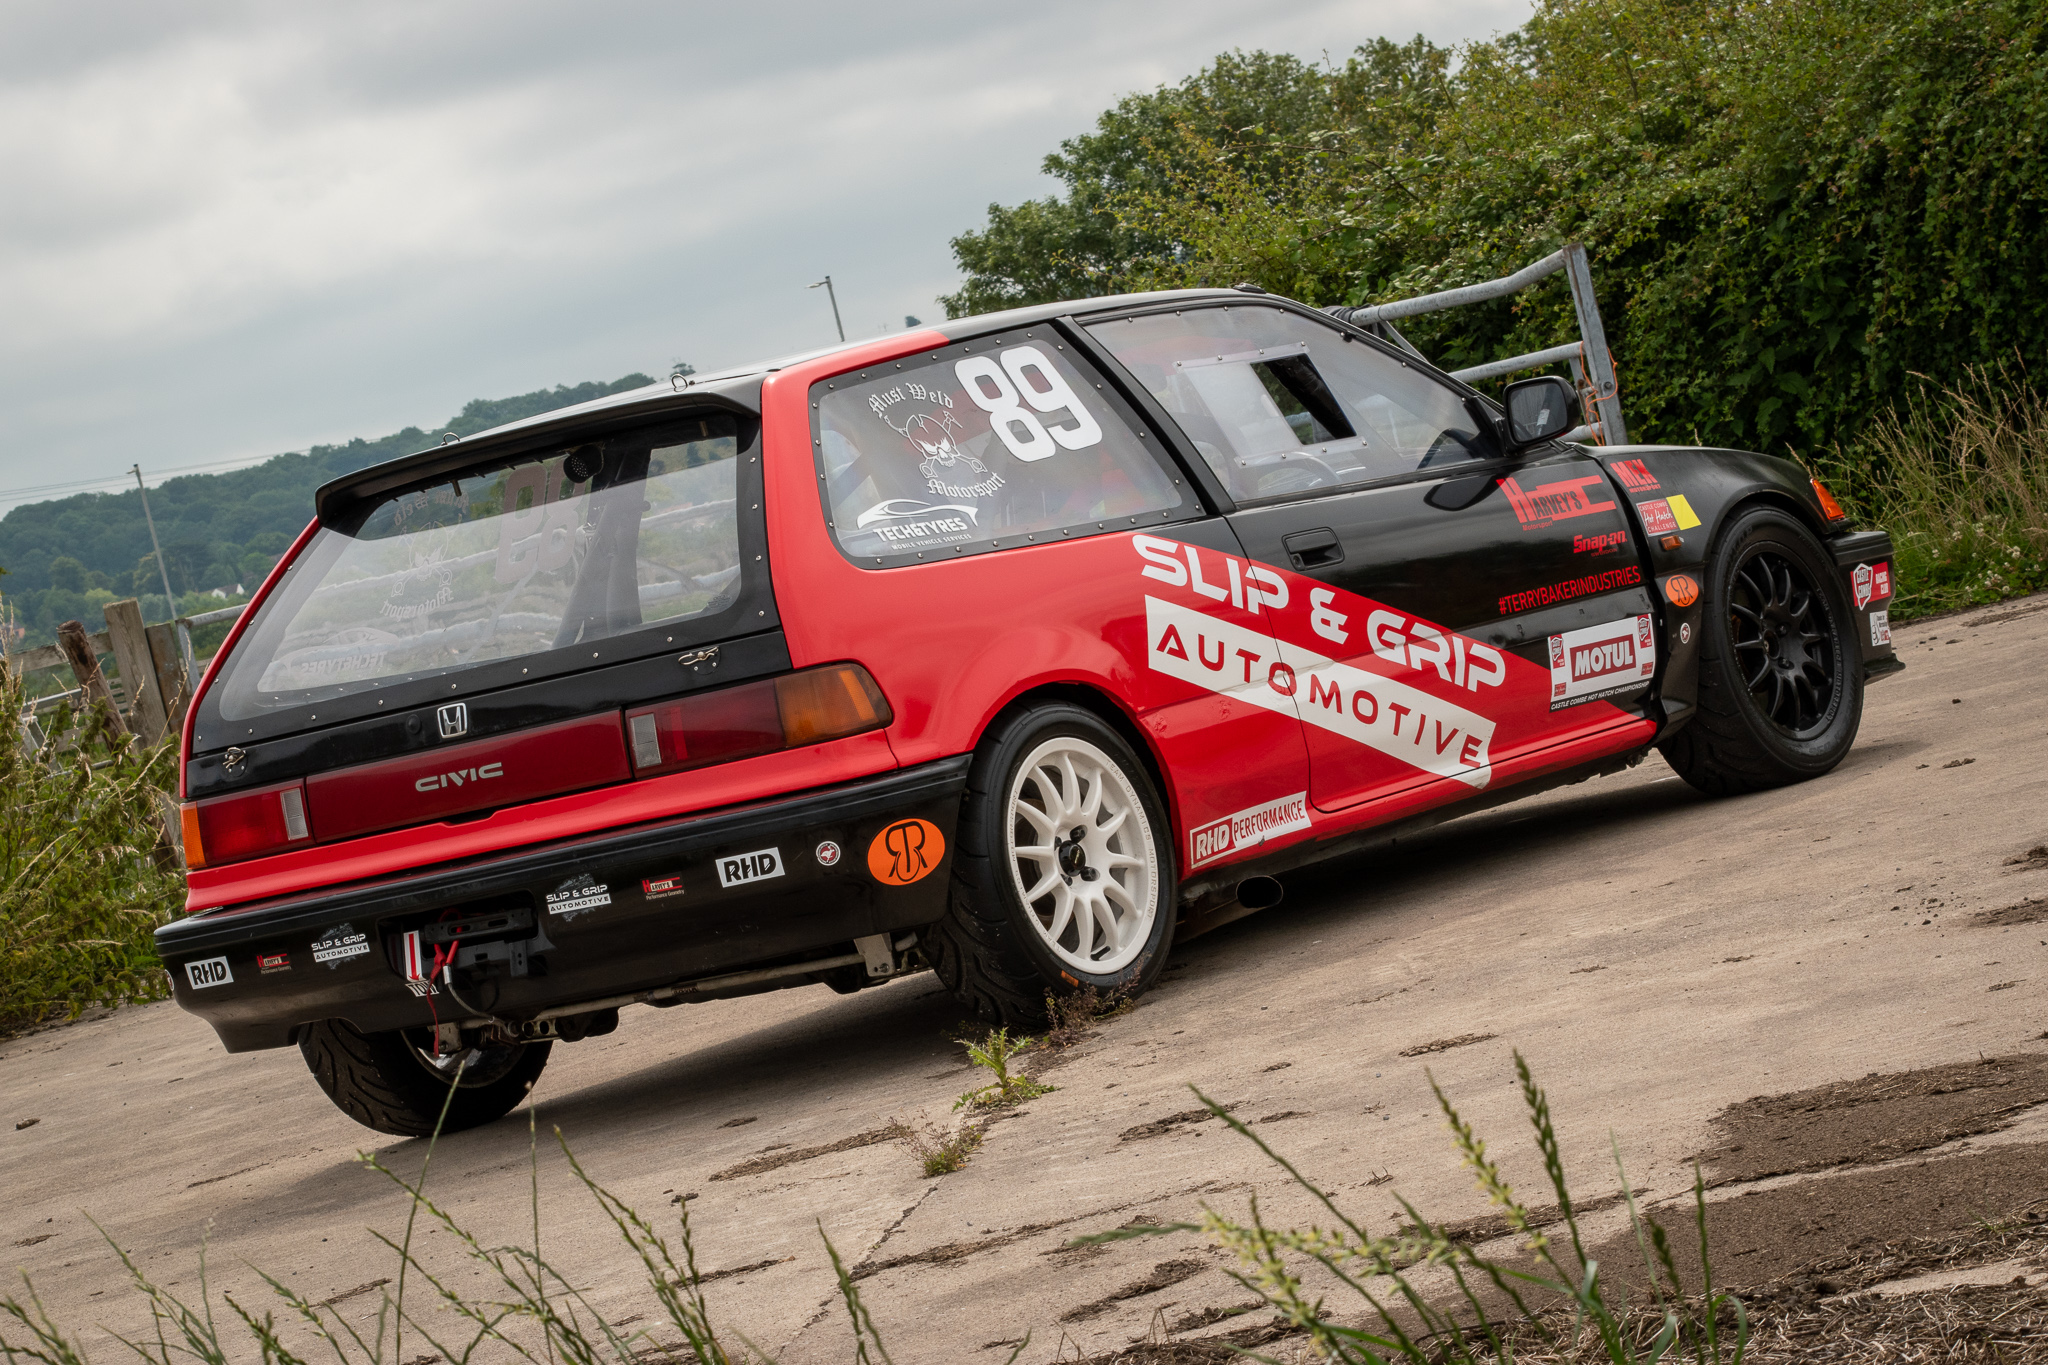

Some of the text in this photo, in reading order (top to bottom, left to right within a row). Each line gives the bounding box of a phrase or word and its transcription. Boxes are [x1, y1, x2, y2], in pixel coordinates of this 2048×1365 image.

[868, 386, 906, 419] Must
[955, 346, 1103, 462] 89
[927, 472, 1005, 498] Motorsport
[1496, 477, 1583, 523] HARVEY'S
[873, 517, 968, 542] TECH&TYRES
[1522, 520, 1553, 531] Motorsport
[1647, 522, 1677, 532] CHALLENGE
[917, 537, 942, 548] VEHICLE
[943, 533, 972, 543] SERVICES
[1573, 530, 1626, 554] Snap-on
[1498, 565, 1641, 615] #TERRYBAKERINDUSTRIES
[1132, 534, 1506, 693] SLIP & GRIP
[1574, 640, 1634, 677] MOTUL
[1156, 623, 1483, 769] AUTOMOTIVE
[1550, 681, 1650, 711] CASTLE COMBE HOT HATCH CHAMPIONSHIP
[415, 762, 504, 792] CIVIC
[1106, 759, 1157, 918] TEAM DYNAMICS MOTORSPORT
[1196, 800, 1306, 860] RHD PERFORMANCE
[723, 853, 777, 883] RHD
[545, 892, 570, 903] SLIP
[581, 884, 608, 896] GRIP
[550, 895, 609, 912] AUTOMOTIVE
[645, 891, 667, 901] Performance
[311, 933, 367, 952] SLIP & GRIP
[315, 944, 368, 960] AUTOMOTIVE
[189, 961, 227, 986] RHD
